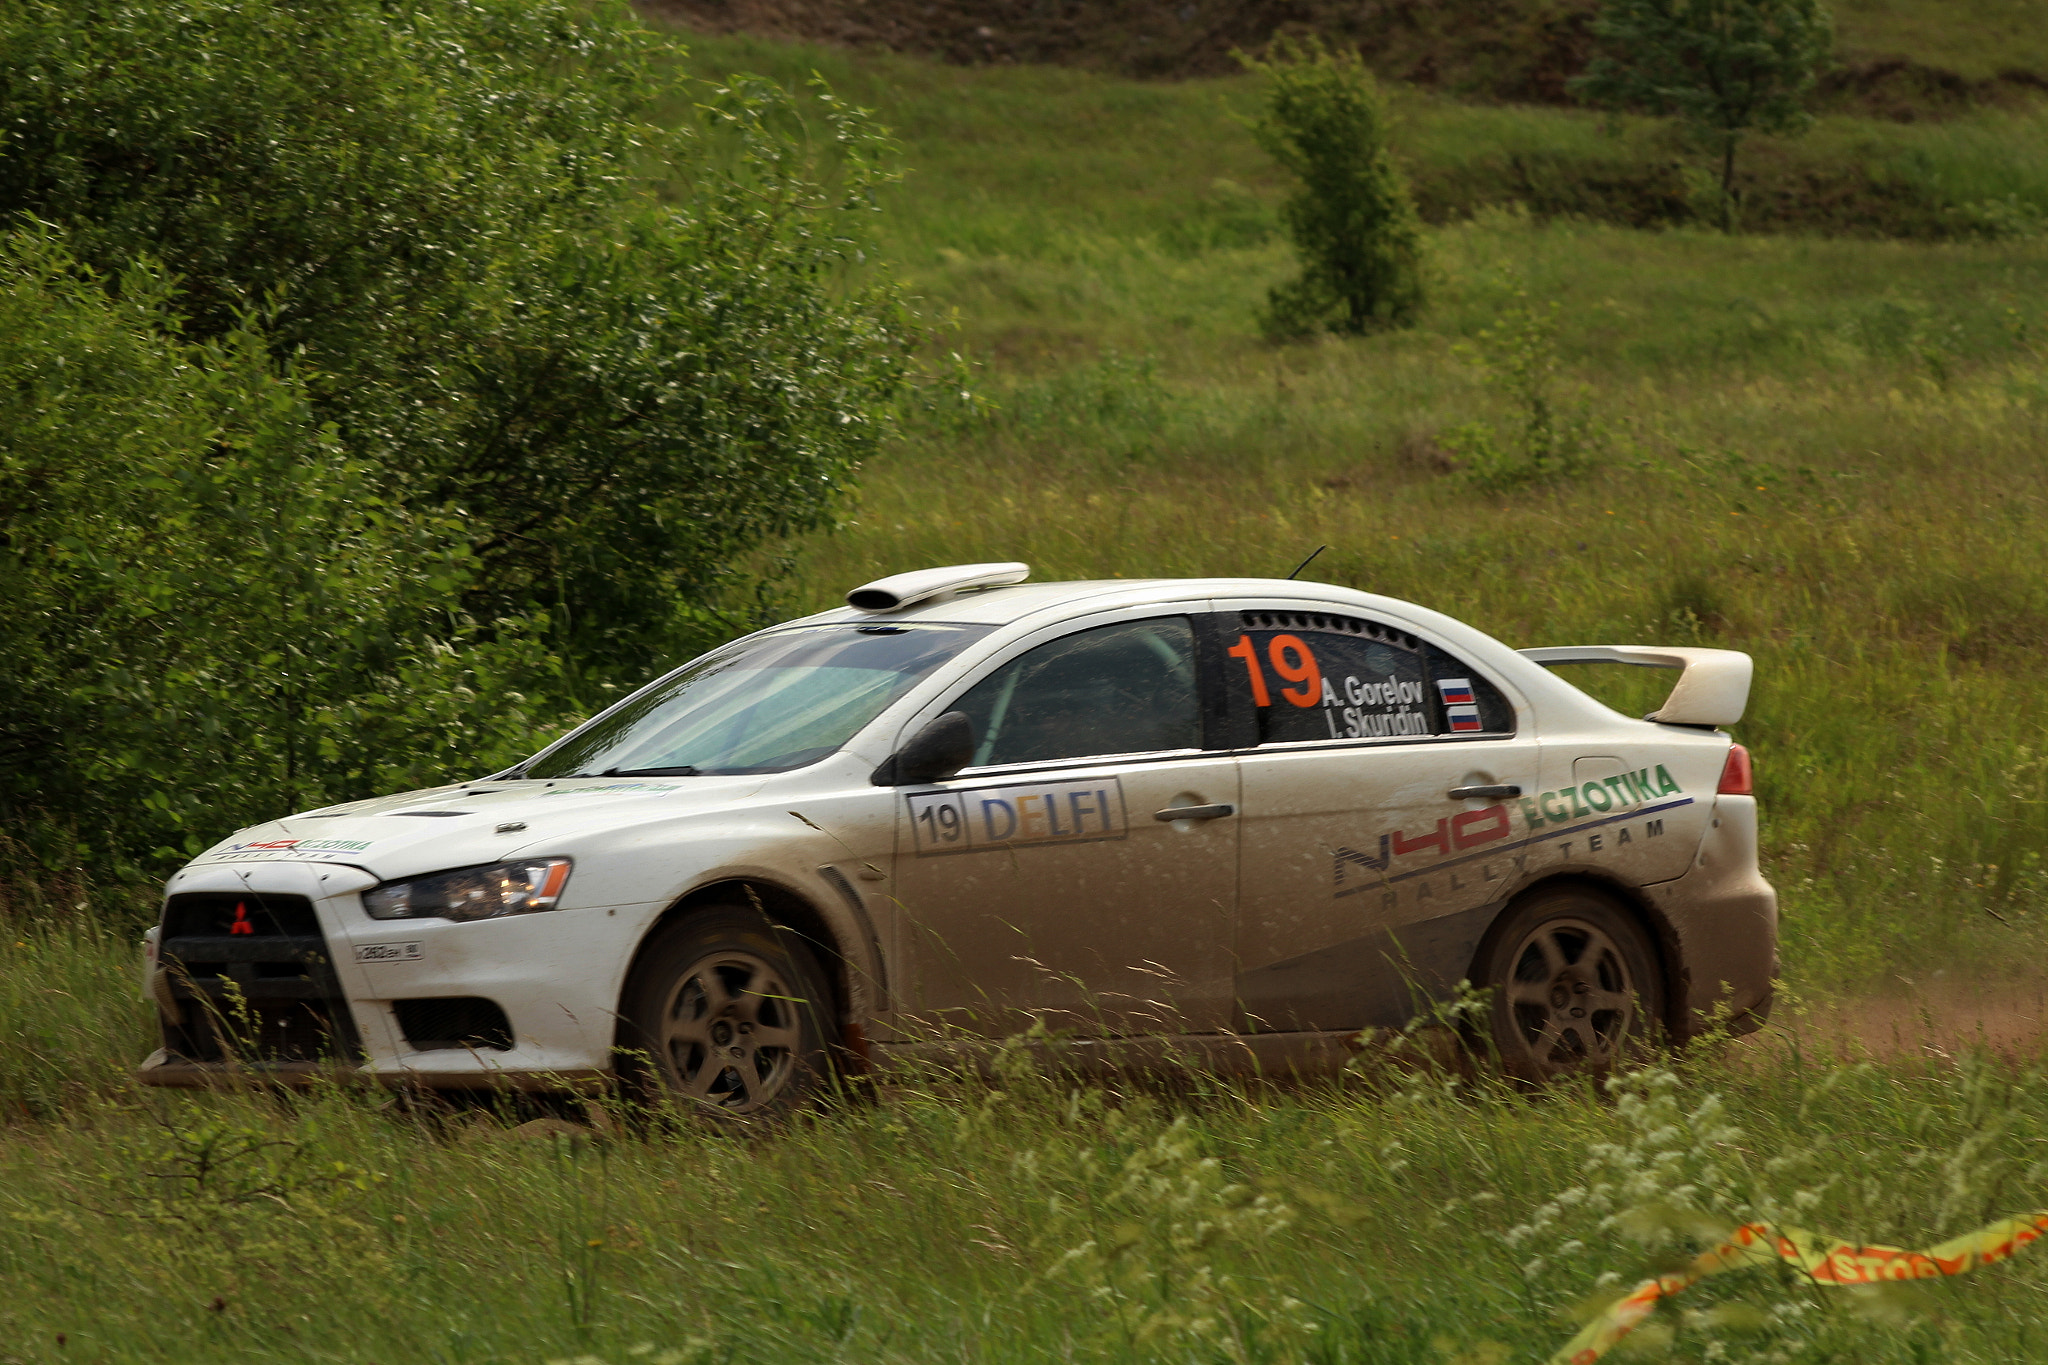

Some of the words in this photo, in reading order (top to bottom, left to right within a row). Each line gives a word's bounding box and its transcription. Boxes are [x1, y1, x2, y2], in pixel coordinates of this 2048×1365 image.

[1228, 634, 1323, 708] 19
[1321, 676, 1344, 707] A.
[1345, 674, 1423, 706] Gorelov
[1343, 706, 1429, 738] Skuridin
[918, 804, 962, 844] 19
[981, 789, 1112, 841] DELFI
[1334, 803, 1511, 886] N40
[1519, 763, 1684, 831] EGZOTIKA
[1559, 818, 1665, 861] TEAM
